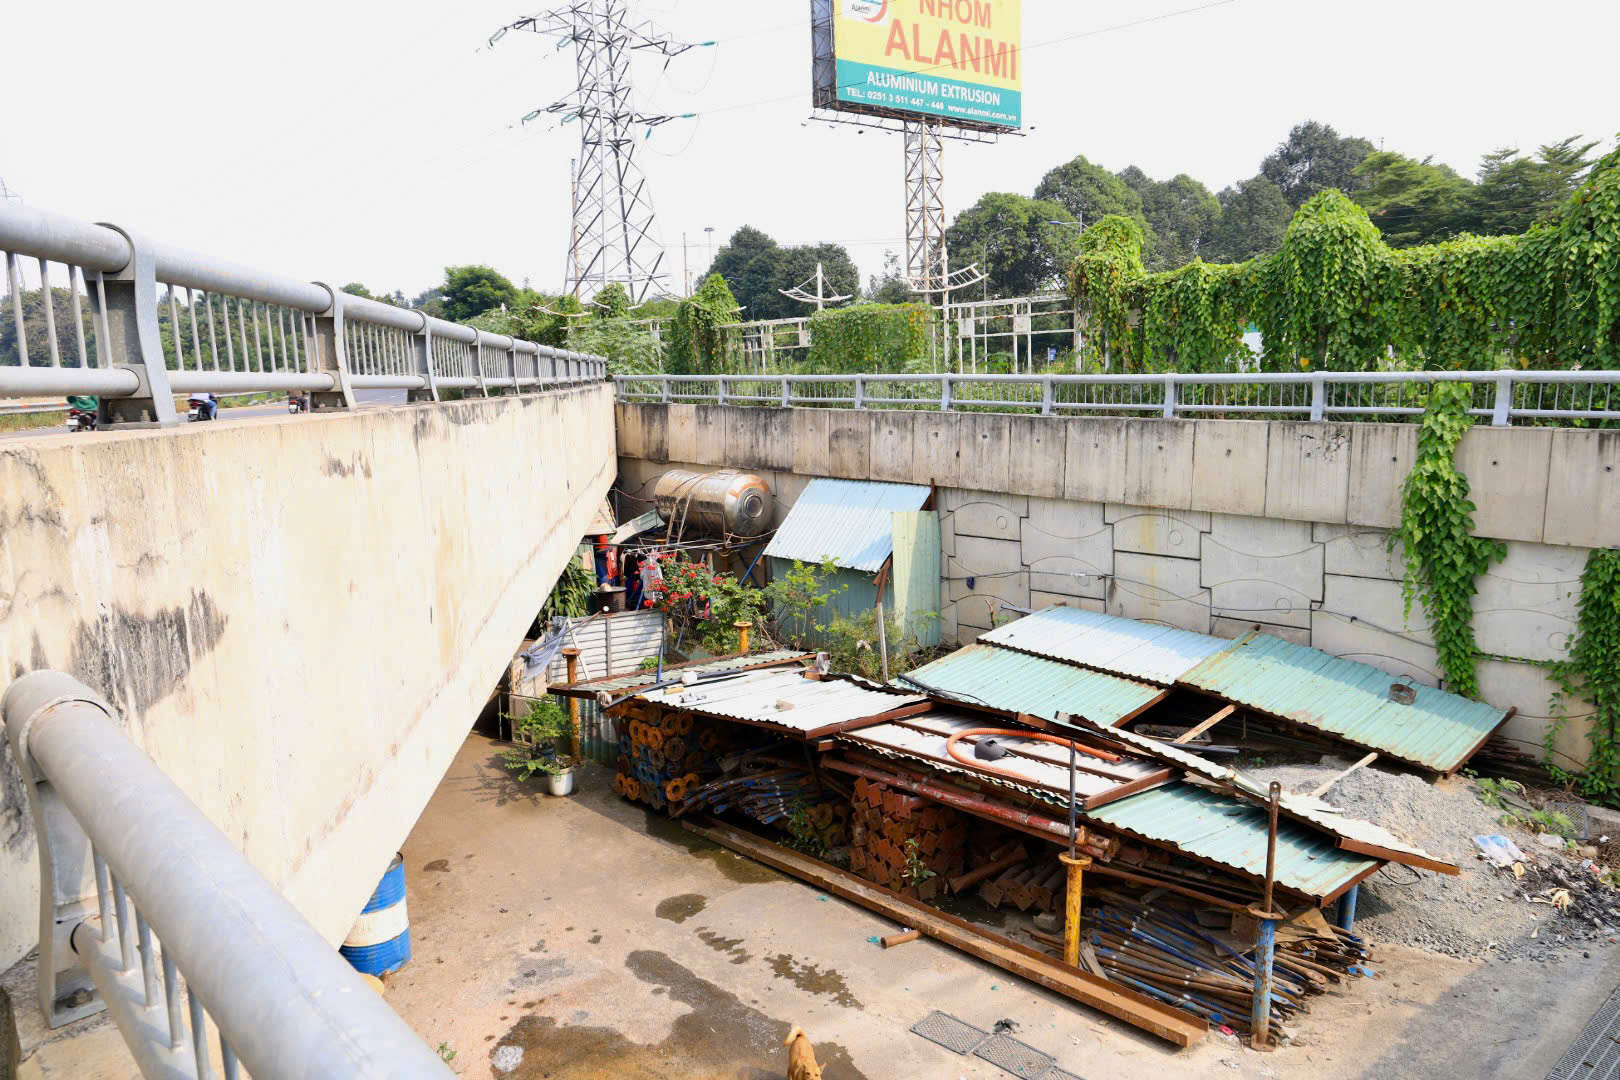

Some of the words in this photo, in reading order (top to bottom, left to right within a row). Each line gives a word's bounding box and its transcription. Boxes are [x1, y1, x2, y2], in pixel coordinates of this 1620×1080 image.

[884, 18, 1016, 80] ALANMI
[846, 87, 865, 98] TEL:
[867, 91, 887, 101] 0251
[896, 95, 908, 104] 511
[947, 105, 1017, 121] www.alanmi.com.vn
[867, 71, 938, 97] ALUMINIUM
[941, 83, 1000, 106] EXTRUSION
